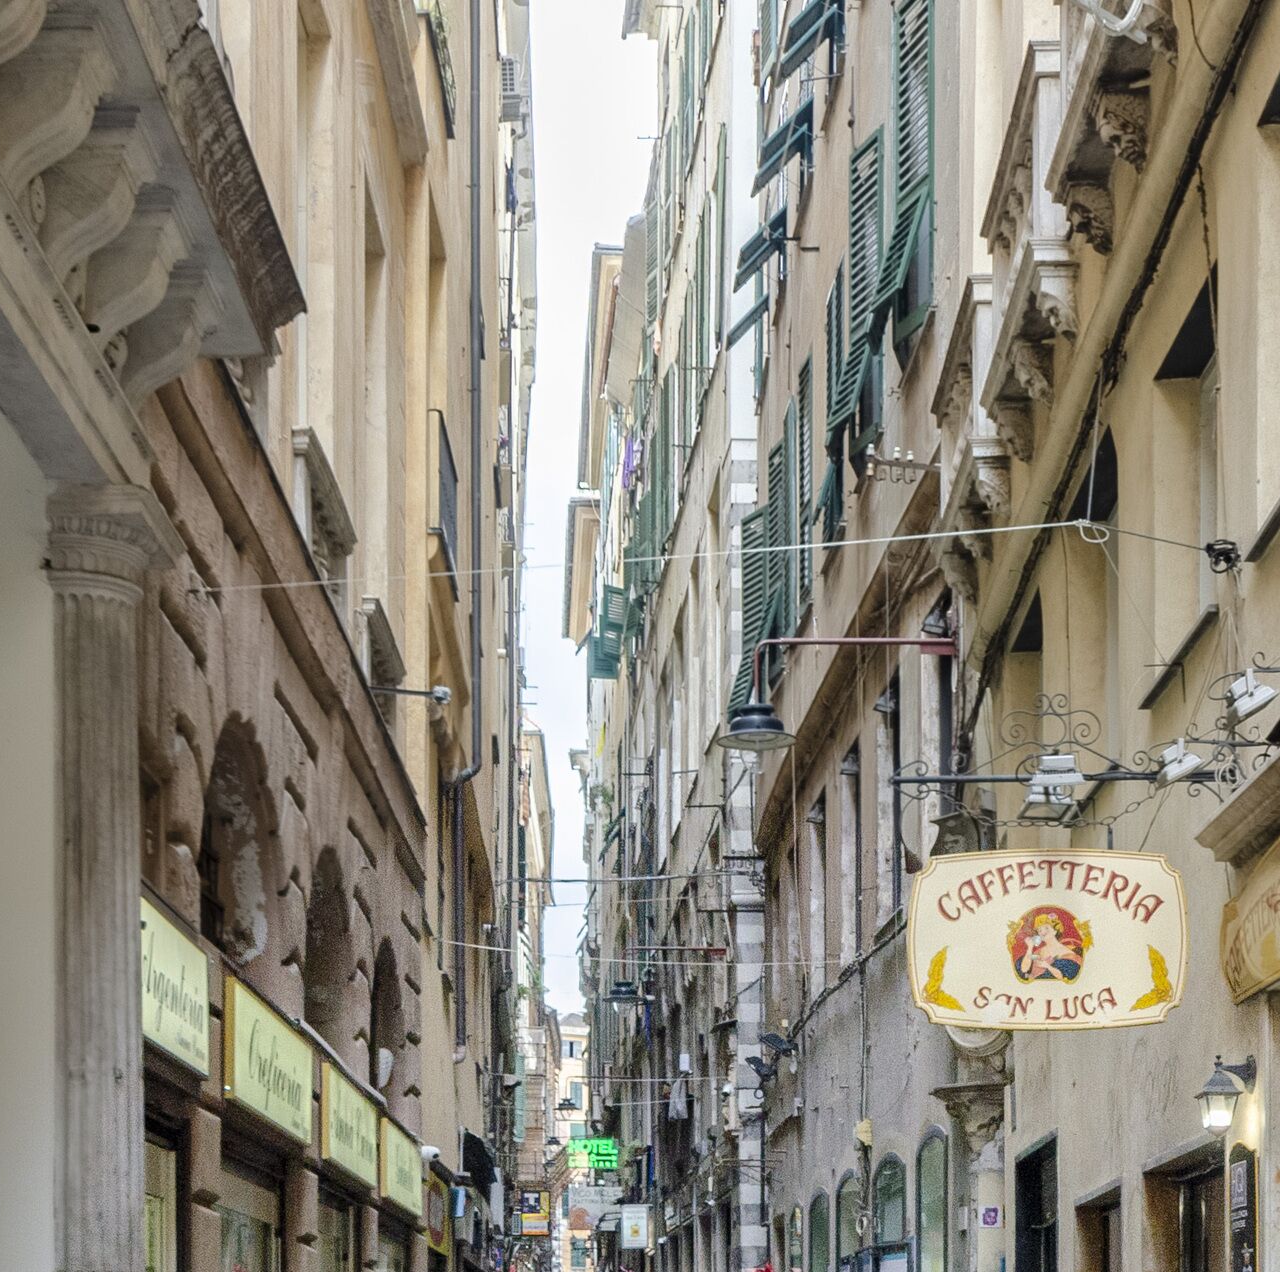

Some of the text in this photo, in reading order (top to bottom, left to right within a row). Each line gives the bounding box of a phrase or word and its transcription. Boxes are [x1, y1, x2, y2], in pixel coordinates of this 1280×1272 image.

[937, 859, 1165, 924] CAFFETTERIA
[1043, 986, 1119, 1021] LUCA
[567, 1138, 618, 1155] HOTEL
